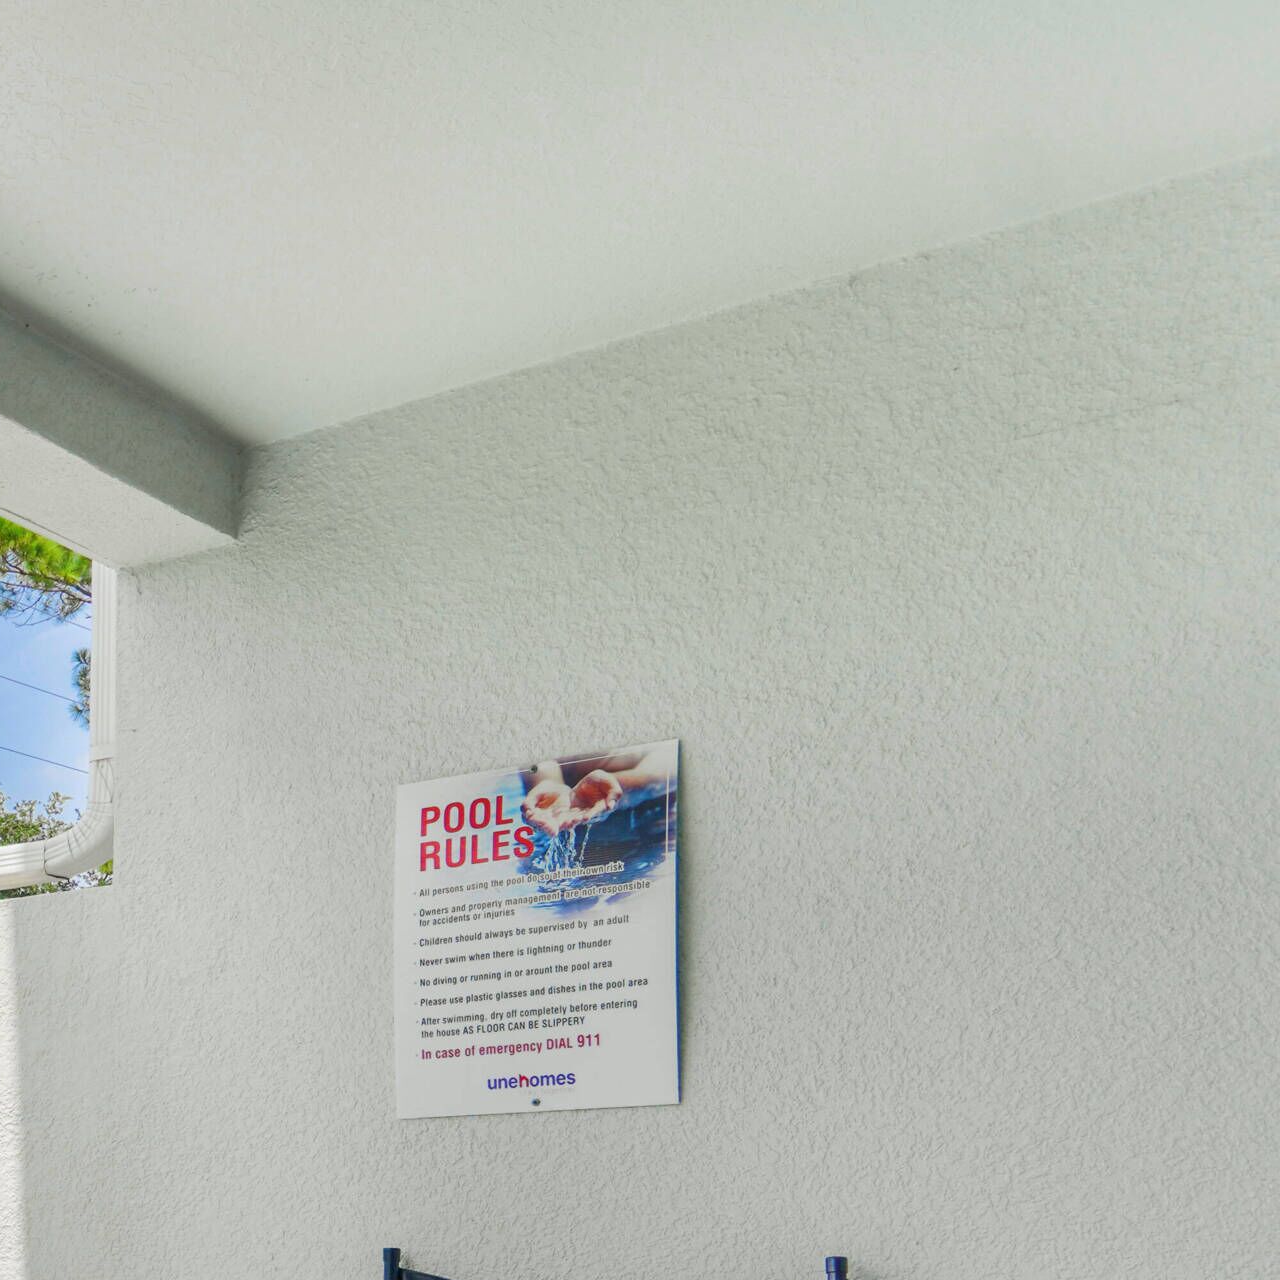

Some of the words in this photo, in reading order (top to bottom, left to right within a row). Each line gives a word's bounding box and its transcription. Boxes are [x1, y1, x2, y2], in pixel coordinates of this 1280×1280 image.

[420, 795, 514, 837] POOL
[420, 825, 535, 872] RULES
[419, 888, 430, 897] All
[432, 885, 464, 897] persons
[466, 881, 489, 892] using
[491, 878, 504, 887] the
[506, 875, 525, 887] pool
[587, 865, 604, 874] own
[606, 861, 624, 871] risk
[419, 904, 449, 917] Owners
[451, 903, 466, 913] and
[505, 892, 560, 906] management
[565, 890, 579, 898] are
[582, 888, 597, 896] not
[599, 880, 650, 894] responsible
[419, 918, 430, 926] for
[432, 913, 471, 925] accidents
[473, 912, 481, 920] or
[484, 908, 515, 919] injuries
[419, 937, 453, 947] Children
[455, 932, 482, 942] should
[485, 928, 513, 939] always
[516, 927, 527, 935] be
[528, 921, 575, 935] supervised
[578, 919, 588, 930] by
[593, 918, 604, 926] an
[607, 914, 629, 925] adult
[420, 957, 443, 967] Never
[445, 954, 466, 964] swim
[469, 951, 490, 961] when
[493, 949, 514, 959] there
[517, 948, 524, 956] is
[567, 943, 576, 951] or
[579, 938, 611, 949] thunder
[420, 978, 431, 987] No
[432, 975, 457, 986] diving
[460, 975, 468, 983] or
[470, 971, 501, 981] running
[504, 970, 512, 978] in
[514, 969, 523, 977] or
[555, 963, 569, 973] the
[571, 961, 590, 972] pool
[593, 959, 612, 969] area
[420, 998, 447, 1007] Please
[449, 996, 463, 1004] use
[466, 992, 493, 1003] plastic
[496, 990, 527, 1001] glasses
[530, 986, 545, 996] and
[548, 984, 576, 995] dishes
[579, 982, 587, 991] in
[589, 981, 603, 990] the
[606, 979, 625, 990] pool
[628, 978, 648, 987] area
[421, 1016, 441, 1026] After
[490, 1010, 504, 1020] dry
[506, 1008, 517, 1018] off
[519, 1005, 567, 1018] completely
[569, 1002, 598, 1012] before
[600, 999, 638, 1010] entering
[421, 1029, 434, 1038] the
[436, 1027, 460, 1037] house
[462, 1025, 474, 1035] AS
[476, 1023, 505, 1034] FLOOR
[507, 1020, 526, 1031] CAN
[528, 1019, 539, 1029] BE
[542, 1016, 585, 1028] SLIPPERY
[421, 1049, 432, 1060] In
[435, 1048, 461, 1059] case
[464, 1045, 475, 1057] of
[479, 1042, 542, 1056] emergency
[546, 1038, 573, 1050] DIAL
[577, 1033, 600, 1048] 911
[487, 1072, 576, 1090] unehomes
